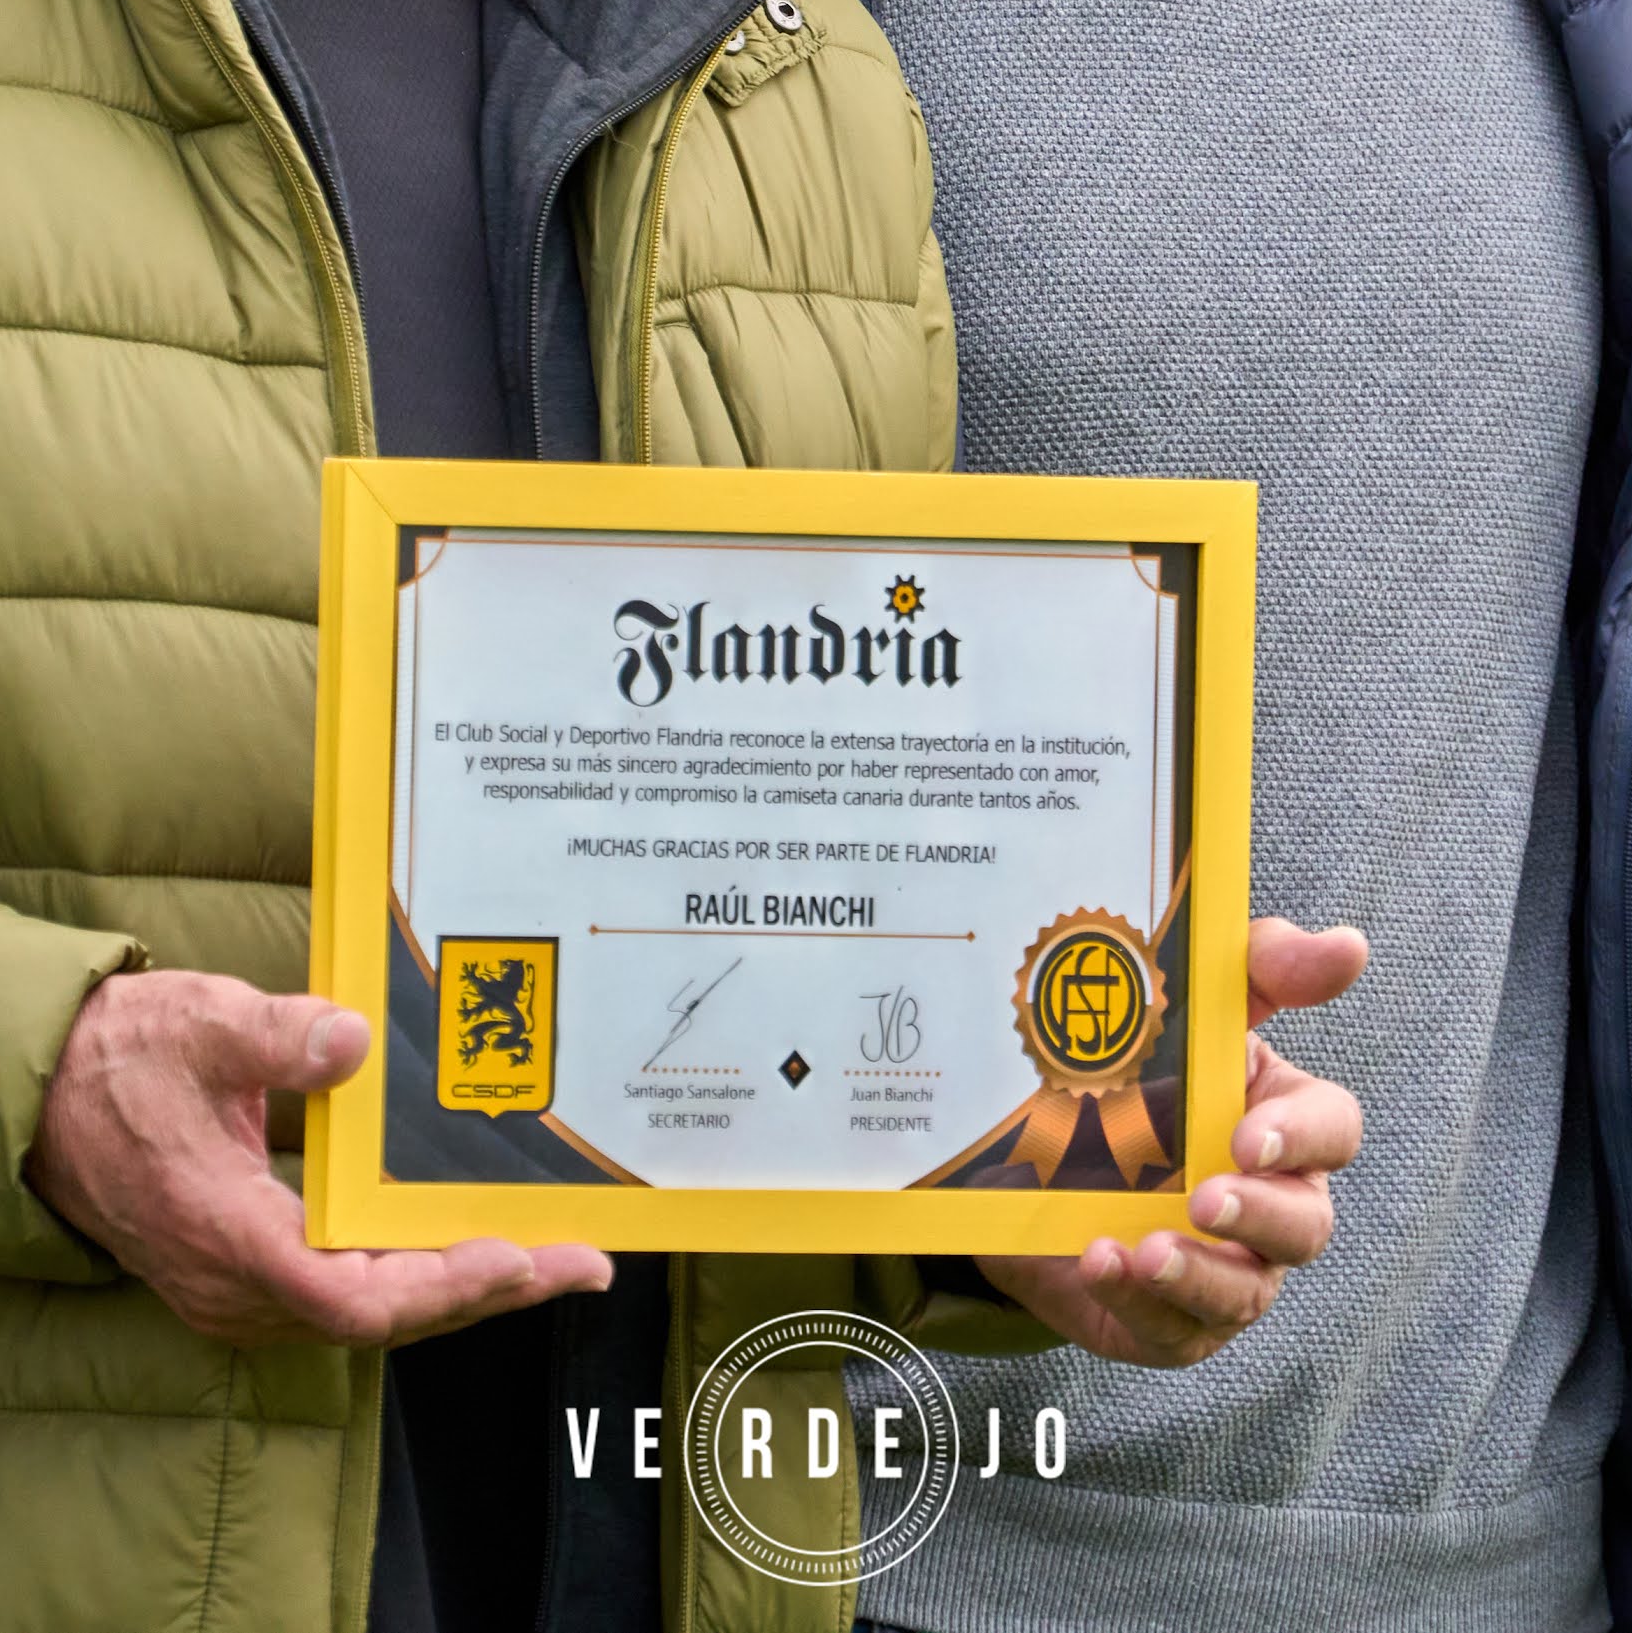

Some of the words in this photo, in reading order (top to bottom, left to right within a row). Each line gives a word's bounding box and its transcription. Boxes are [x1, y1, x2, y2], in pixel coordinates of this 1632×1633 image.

[613, 575, 962, 707] Flandria
[435, 723, 450, 741] El
[455, 723, 494, 743] Club
[499, 724, 547, 744] Social
[553, 730, 563, 748] y
[569, 726, 651, 749] Deportivo
[656, 727, 723, 747] Flandria
[730, 732, 805, 749] reconoce
[810, 730, 824, 749] la
[830, 734, 895, 750] extensa
[994, 738, 1015, 753] en
[1022, 734, 1036, 754] la
[1041, 735, 1131, 759] institución,
[464, 755, 474, 775] y
[480, 757, 546, 775] expresa
[552, 758, 571, 772] su
[577, 753, 612, 773] más
[617, 756, 678, 774] sincero
[682, 756, 812, 779] agradecimiento
[817, 763, 845, 781] por
[851, 759, 899, 779] haber
[903, 762, 1014, 783] representado
[1019, 766, 1049, 782] con
[1054, 768, 1100, 786] amor,
[483, 780, 614, 804] responsabilidad
[619, 787, 629, 805] y
[635, 787, 738, 806] compromiso
[743, 785, 757, 804] la
[763, 787, 838, 806] camiseta
[842, 788, 903, 806] canaria
[908, 789, 974, 808] durante
[979, 792, 1031, 809] tantos
[1036, 791, 1081, 810] años.
[652, 840, 730, 859] GRACIAS
[735, 842, 771, 860] POR
[776, 842, 810, 860] SER
[815, 843, 870, 862] PARTE
[875, 844, 900, 862] DE
[905, 845, 996, 864] FLANDRIA!
[685, 885, 756, 925] RAÚL
[763, 895, 874, 927] BIANCHI
[451, 1084, 536, 1098] CSDF
[624, 1083, 684, 1103] Santiago
[686, 1084, 756, 1100] Sansalone
[849, 1087, 881, 1102] Juan
[884, 1087, 934, 1102] Bianchi
[647, 1114, 731, 1129] SECRETARIO
[850, 1117, 933, 1132] PRESIDENTE
